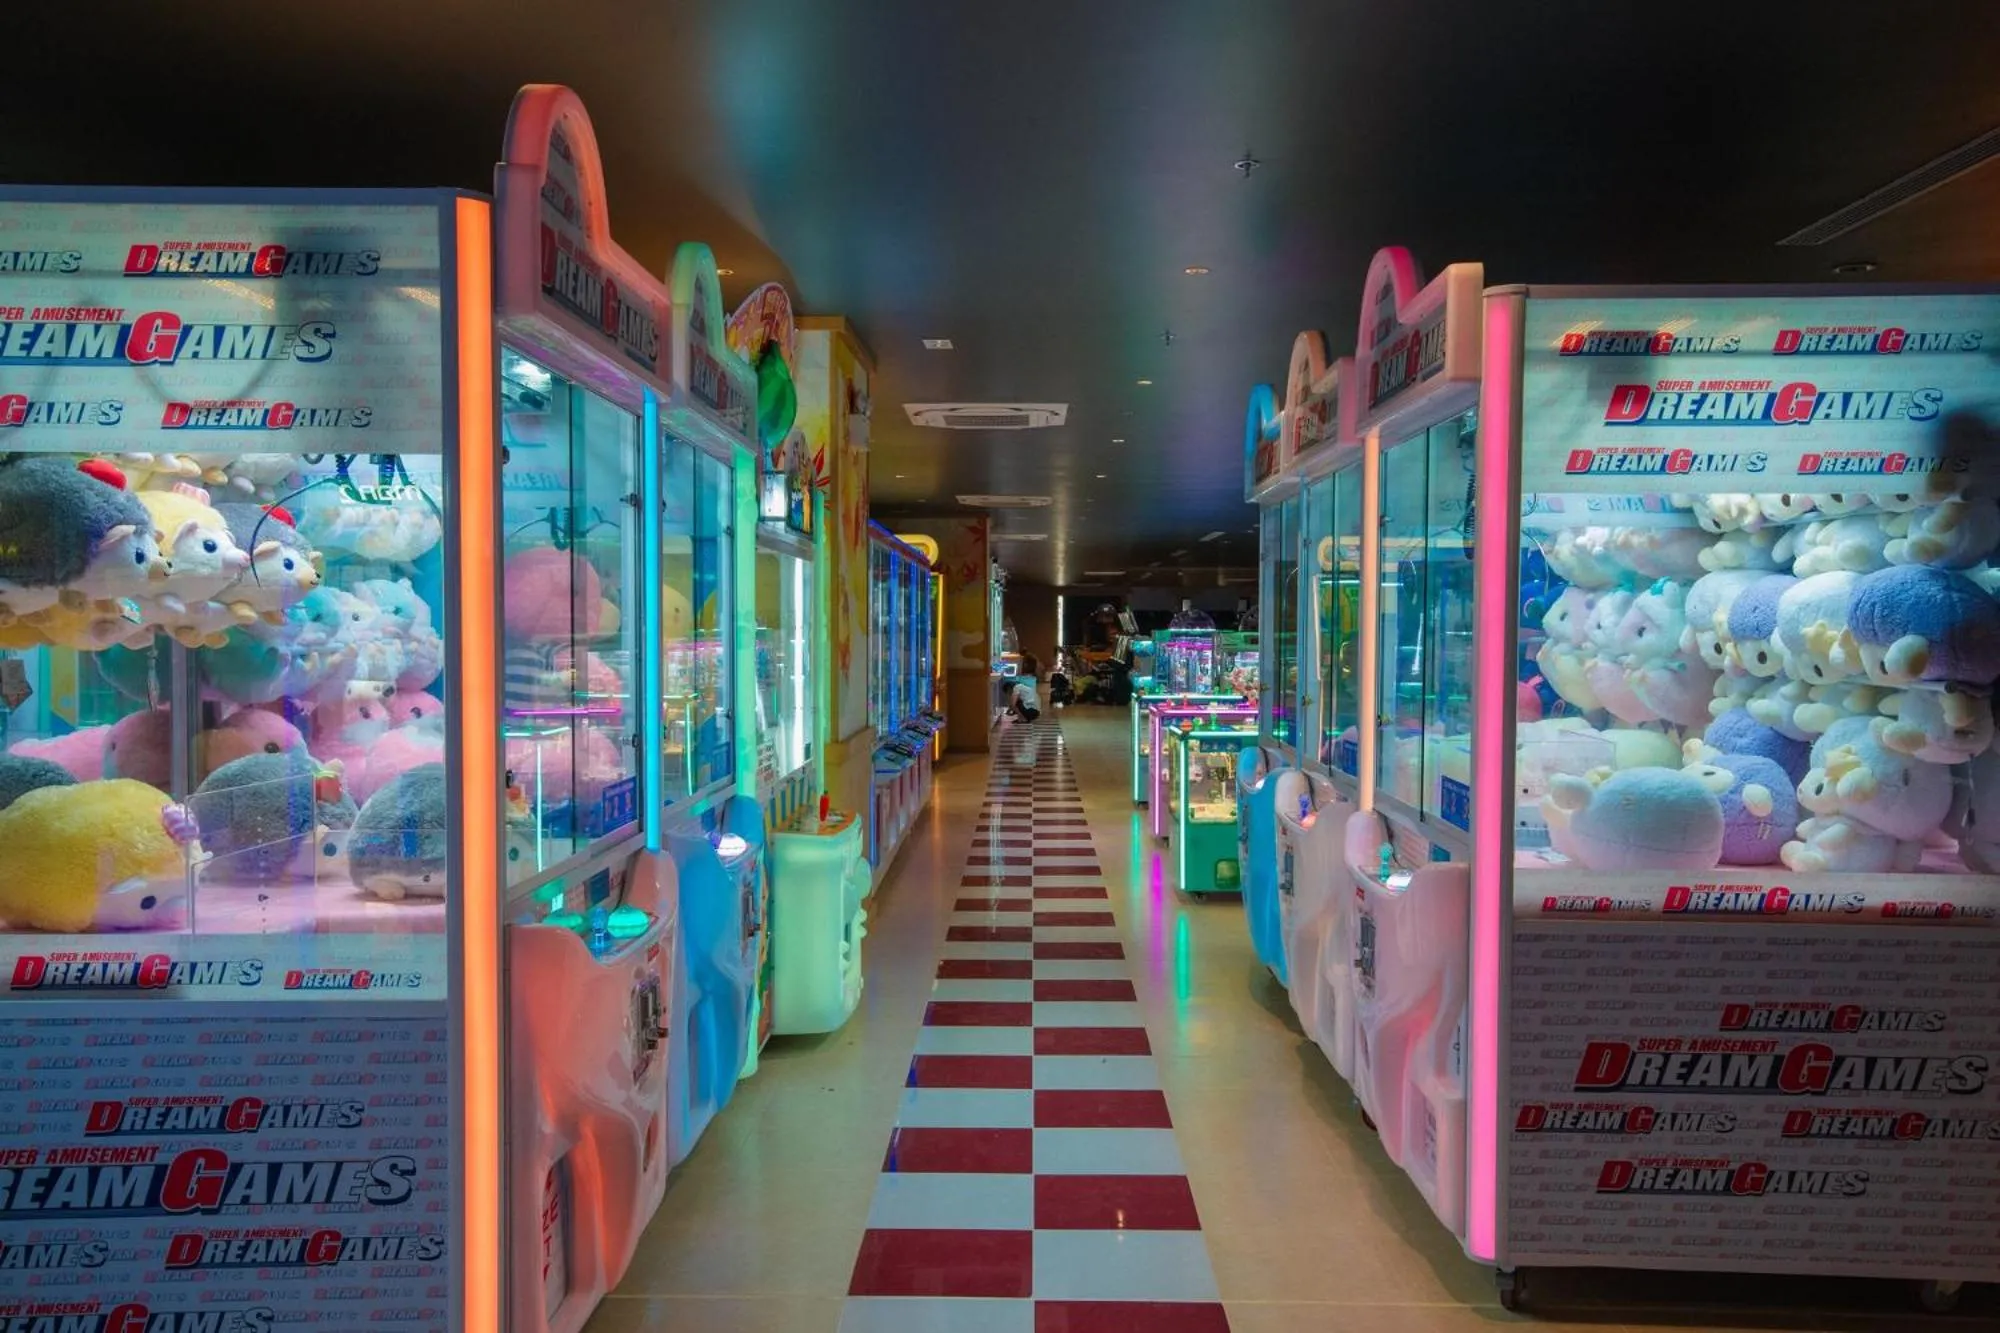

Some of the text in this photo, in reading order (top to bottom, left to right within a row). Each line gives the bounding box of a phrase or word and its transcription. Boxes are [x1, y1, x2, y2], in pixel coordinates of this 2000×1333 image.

[0, 251, 82, 273] AMES
[124, 244, 380, 277] DREAM GAMES
[30, 306, 125, 321] AMUSEMENT
[0, 311, 336, 365] EAM GAMES
[1560, 332, 1741, 356] DREAM GAMES
[1773, 329, 1876, 355] DREAM
[0, 394, 123, 428] GAMES
[161, 401, 373, 429] DREAM GAMES
[1604, 382, 1943, 425] DREAM GAMES
[1565, 449, 1665, 474] DREAM
[1797, 454, 1882, 475] DREAM
[1542, 896, 1596, 912] DREAM
[1663, 886, 1761, 913] DREAM
[11, 954, 263, 990] DREAM GAMES
[284, 970, 352, 989] DREAM
[1720, 1004, 1830, 1031] DREAM
[1831, 1005, 1946, 1032] GAMES
[1638, 1039, 1778, 1053] SUPER AMUSEMENT
[1574, 1041, 1989, 1095] DREAM GAMES
[84, 1101, 224, 1136] DREAM
[225, 1097, 364, 1132] GAMES
[1515, 1105, 1736, 1133] DREAM GAMES
[1781, 1110, 1895, 1138] DREAM
[45, 1146, 160, 1164] AMUSEMENT
[160, 1148, 416, 1214] GAMES
[1597, 1160, 1868, 1196] DREAM GAMES
[0, 1240, 108, 1269] AMES
[165, 1230, 445, 1270] DREAM GAMES
